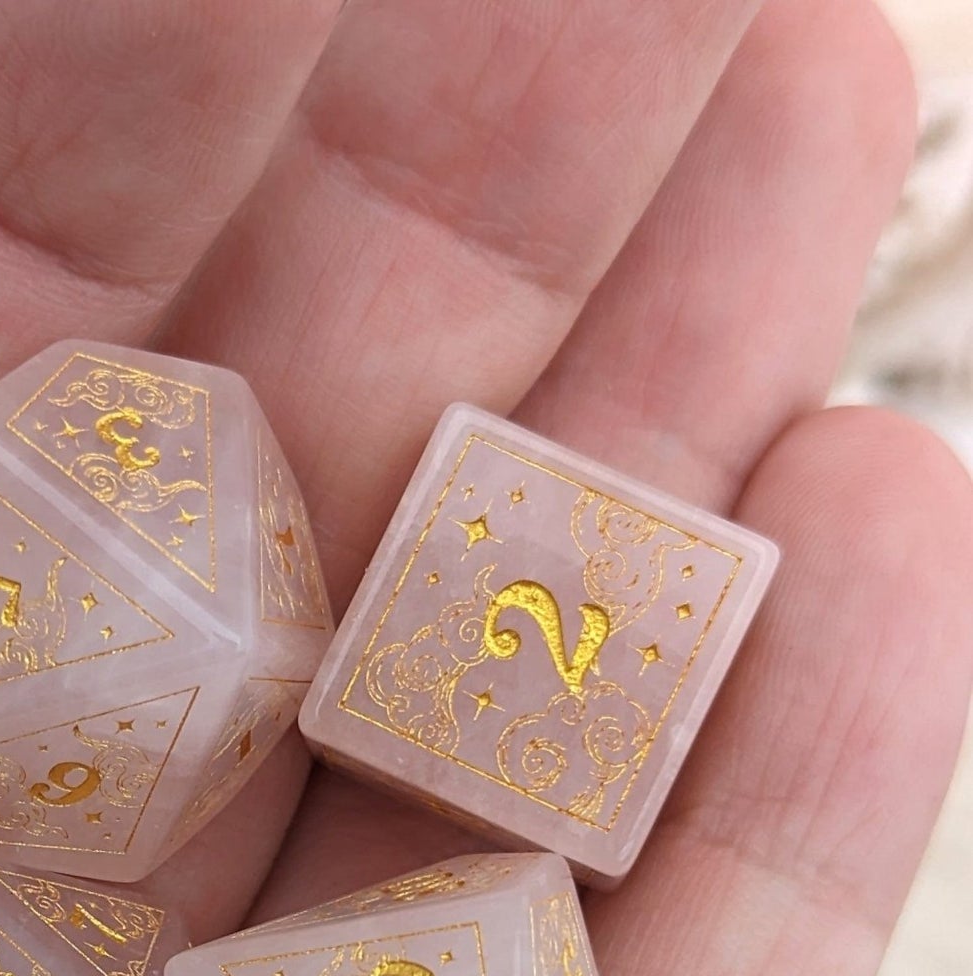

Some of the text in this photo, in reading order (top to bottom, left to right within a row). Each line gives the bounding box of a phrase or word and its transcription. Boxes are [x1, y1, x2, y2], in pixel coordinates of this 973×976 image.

[95, 407, 161, 471] 3
[482, 578, 612, 694] 2
[30, 761, 101, 808] 9
